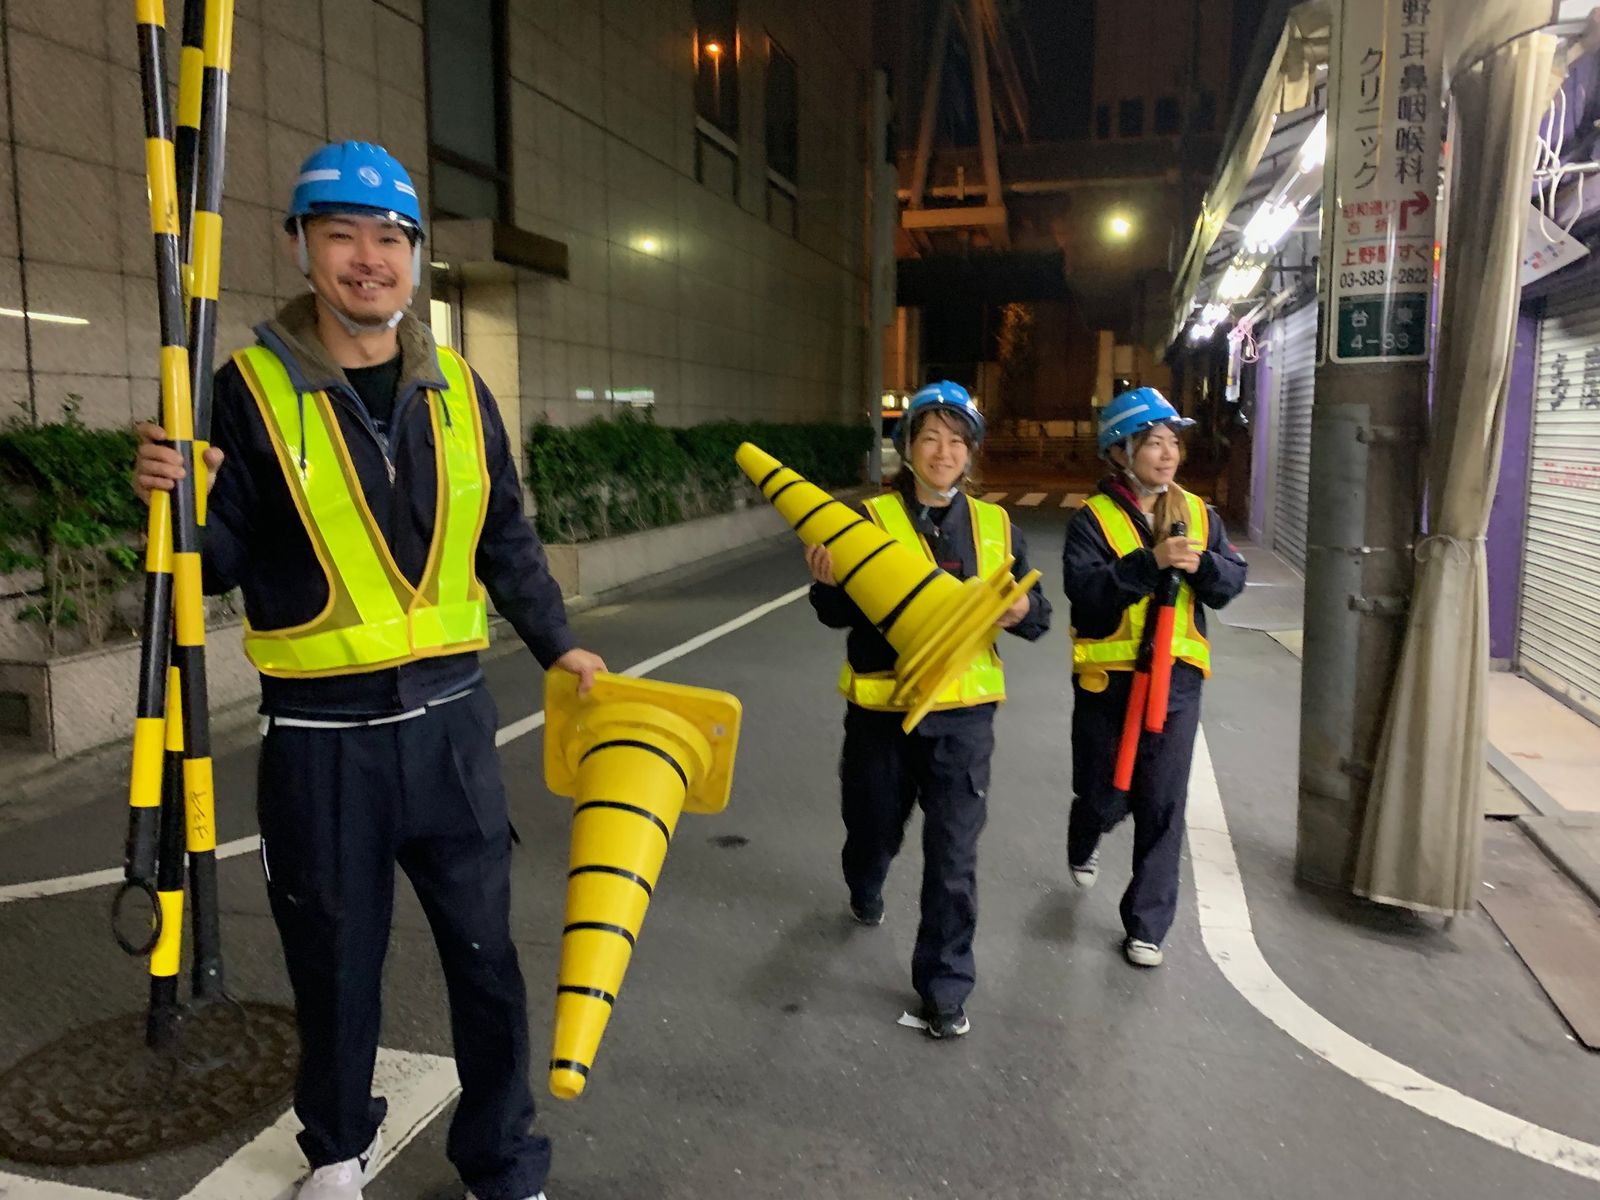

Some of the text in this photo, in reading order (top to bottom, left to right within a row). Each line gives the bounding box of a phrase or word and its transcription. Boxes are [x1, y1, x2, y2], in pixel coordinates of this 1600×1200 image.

[1354, 48, 1384, 190] クリニック
[1340, 267, 1428, 289] 03-383-2822
